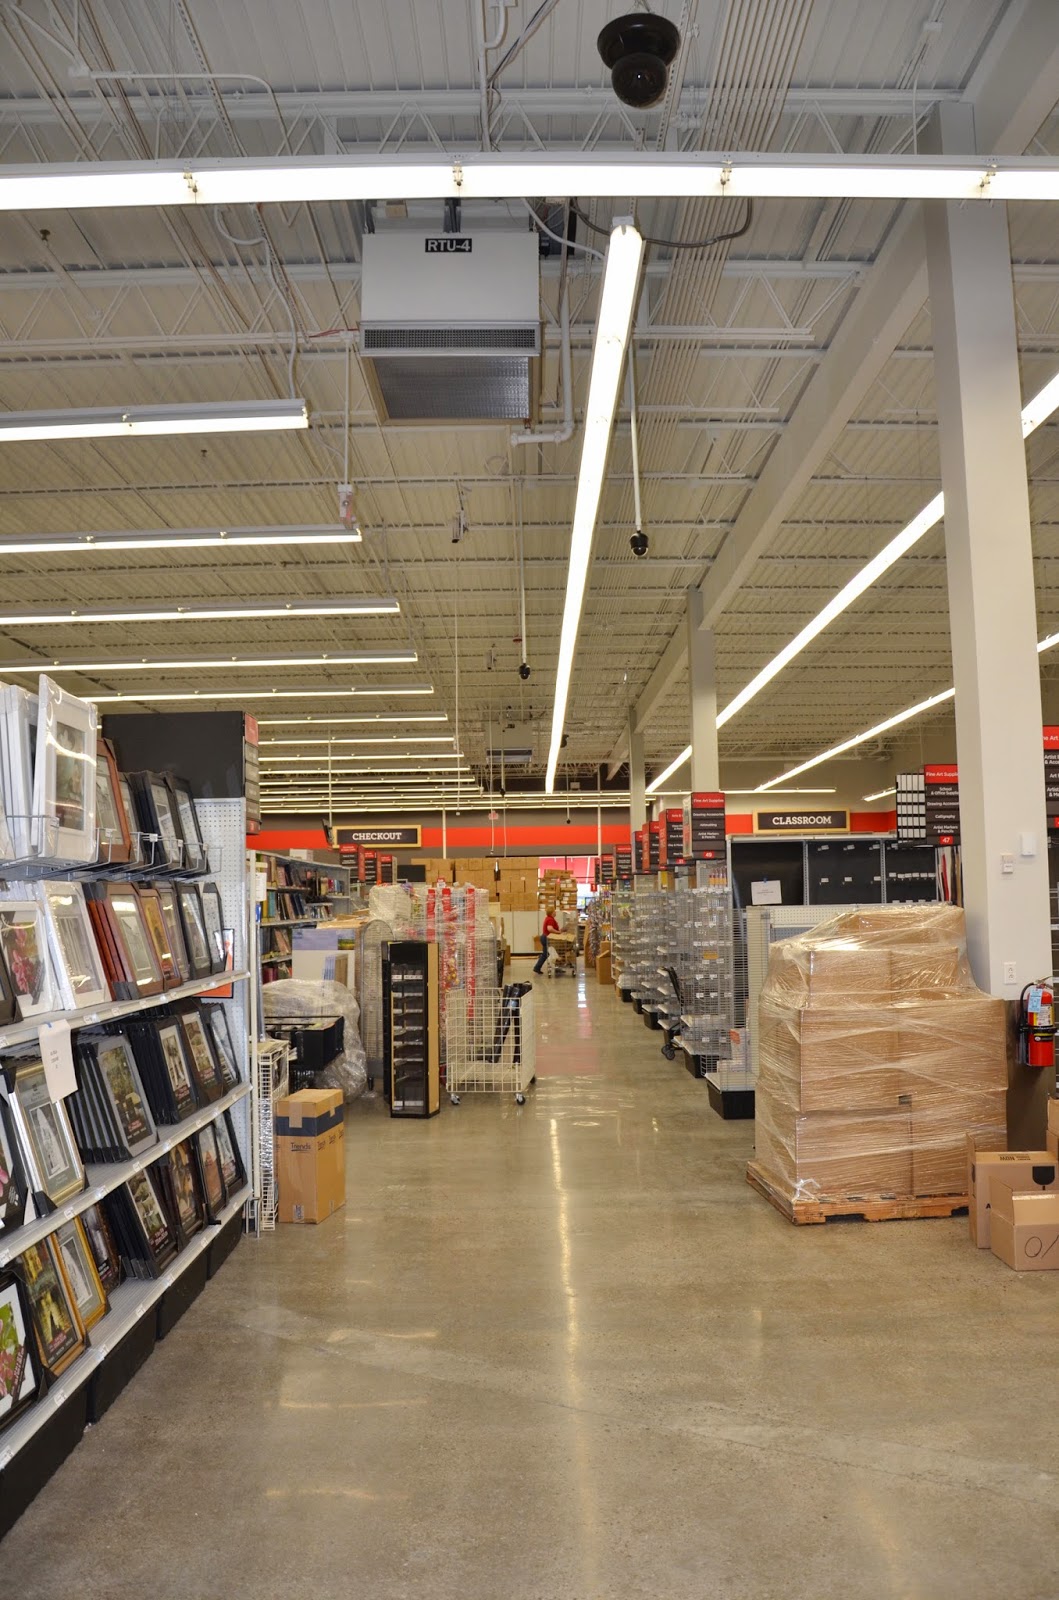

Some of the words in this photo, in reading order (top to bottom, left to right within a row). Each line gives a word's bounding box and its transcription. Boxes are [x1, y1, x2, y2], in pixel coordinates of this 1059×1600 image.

[427, 239, 471, 251] RTU-4
[772, 816, 832, 825] CLASSROOM
[352, 832, 402, 840] CHECKOUT
[291, 1142, 311, 1150] Trends
